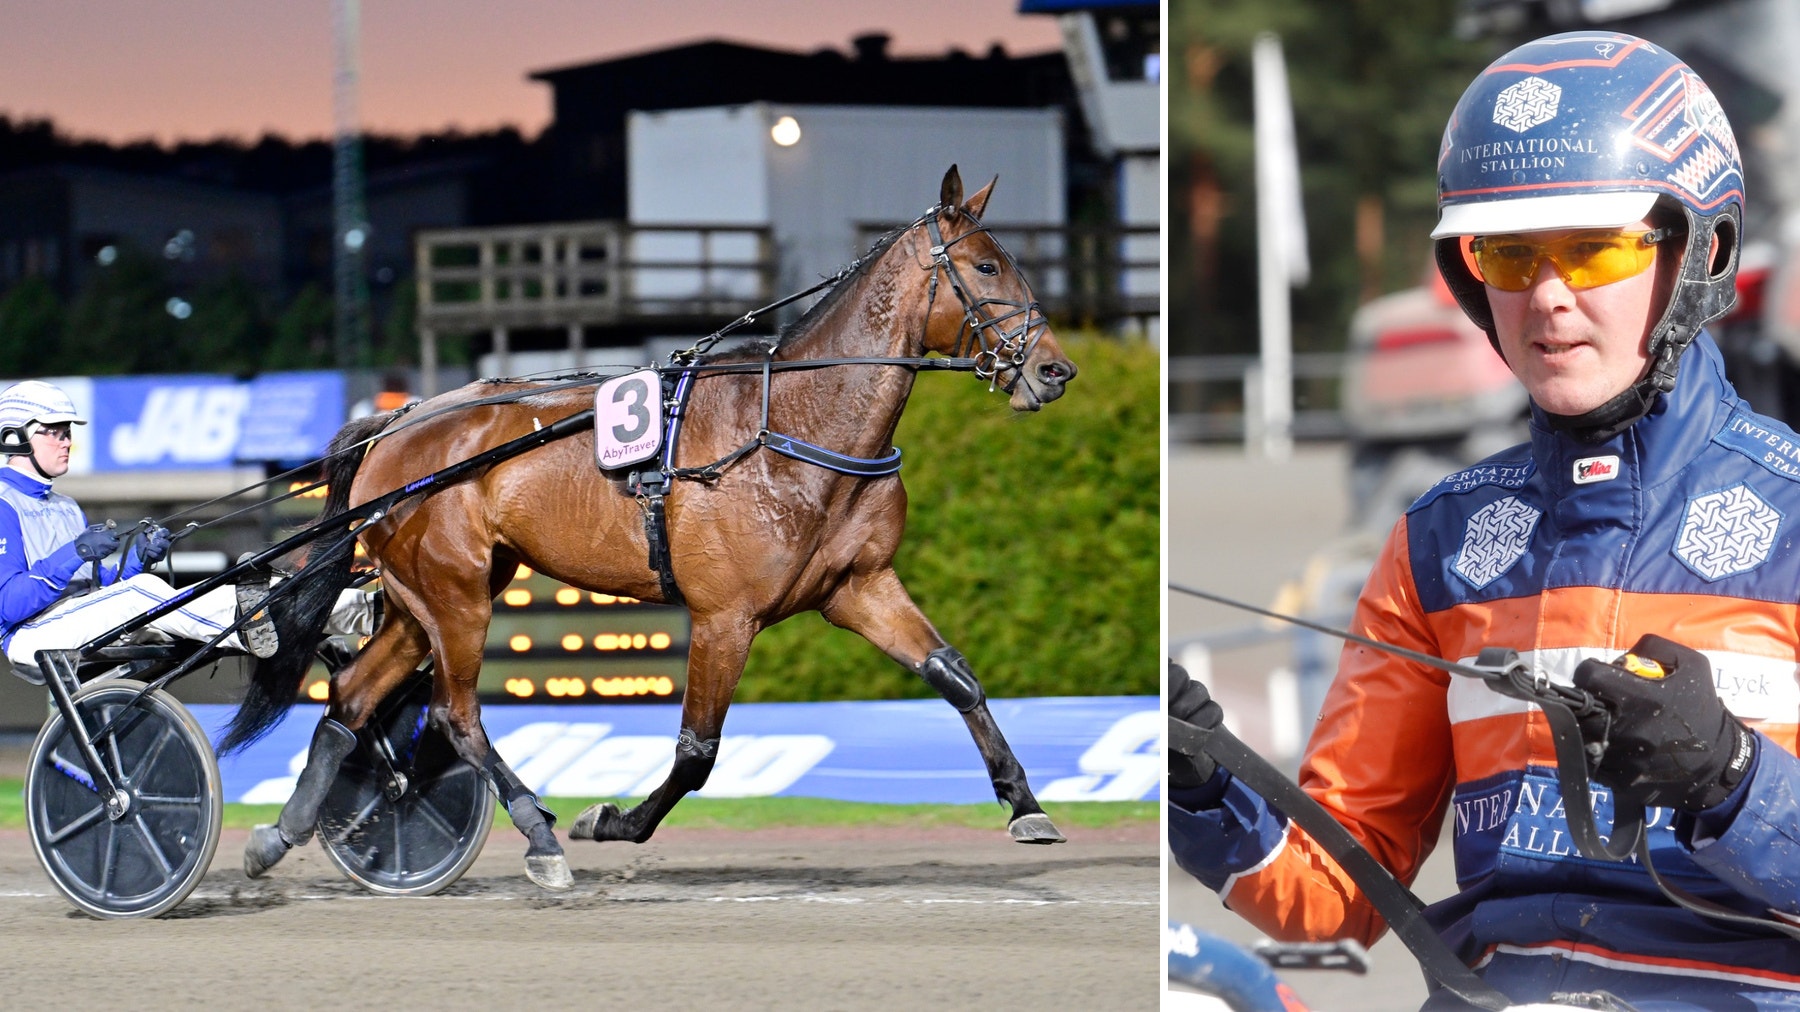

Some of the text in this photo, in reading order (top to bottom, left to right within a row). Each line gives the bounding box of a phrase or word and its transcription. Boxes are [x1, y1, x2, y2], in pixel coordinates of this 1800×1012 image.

[1460, 137, 1599, 163] INTERNATIONAL
[1480, 156, 1566, 174] STALLION
[611, 378, 651, 444] 3
[603, 439, 657, 460] ÅbyTravet
[1453, 475, 1525, 491] STALLION
[1715, 667, 1771, 697] Lyck
